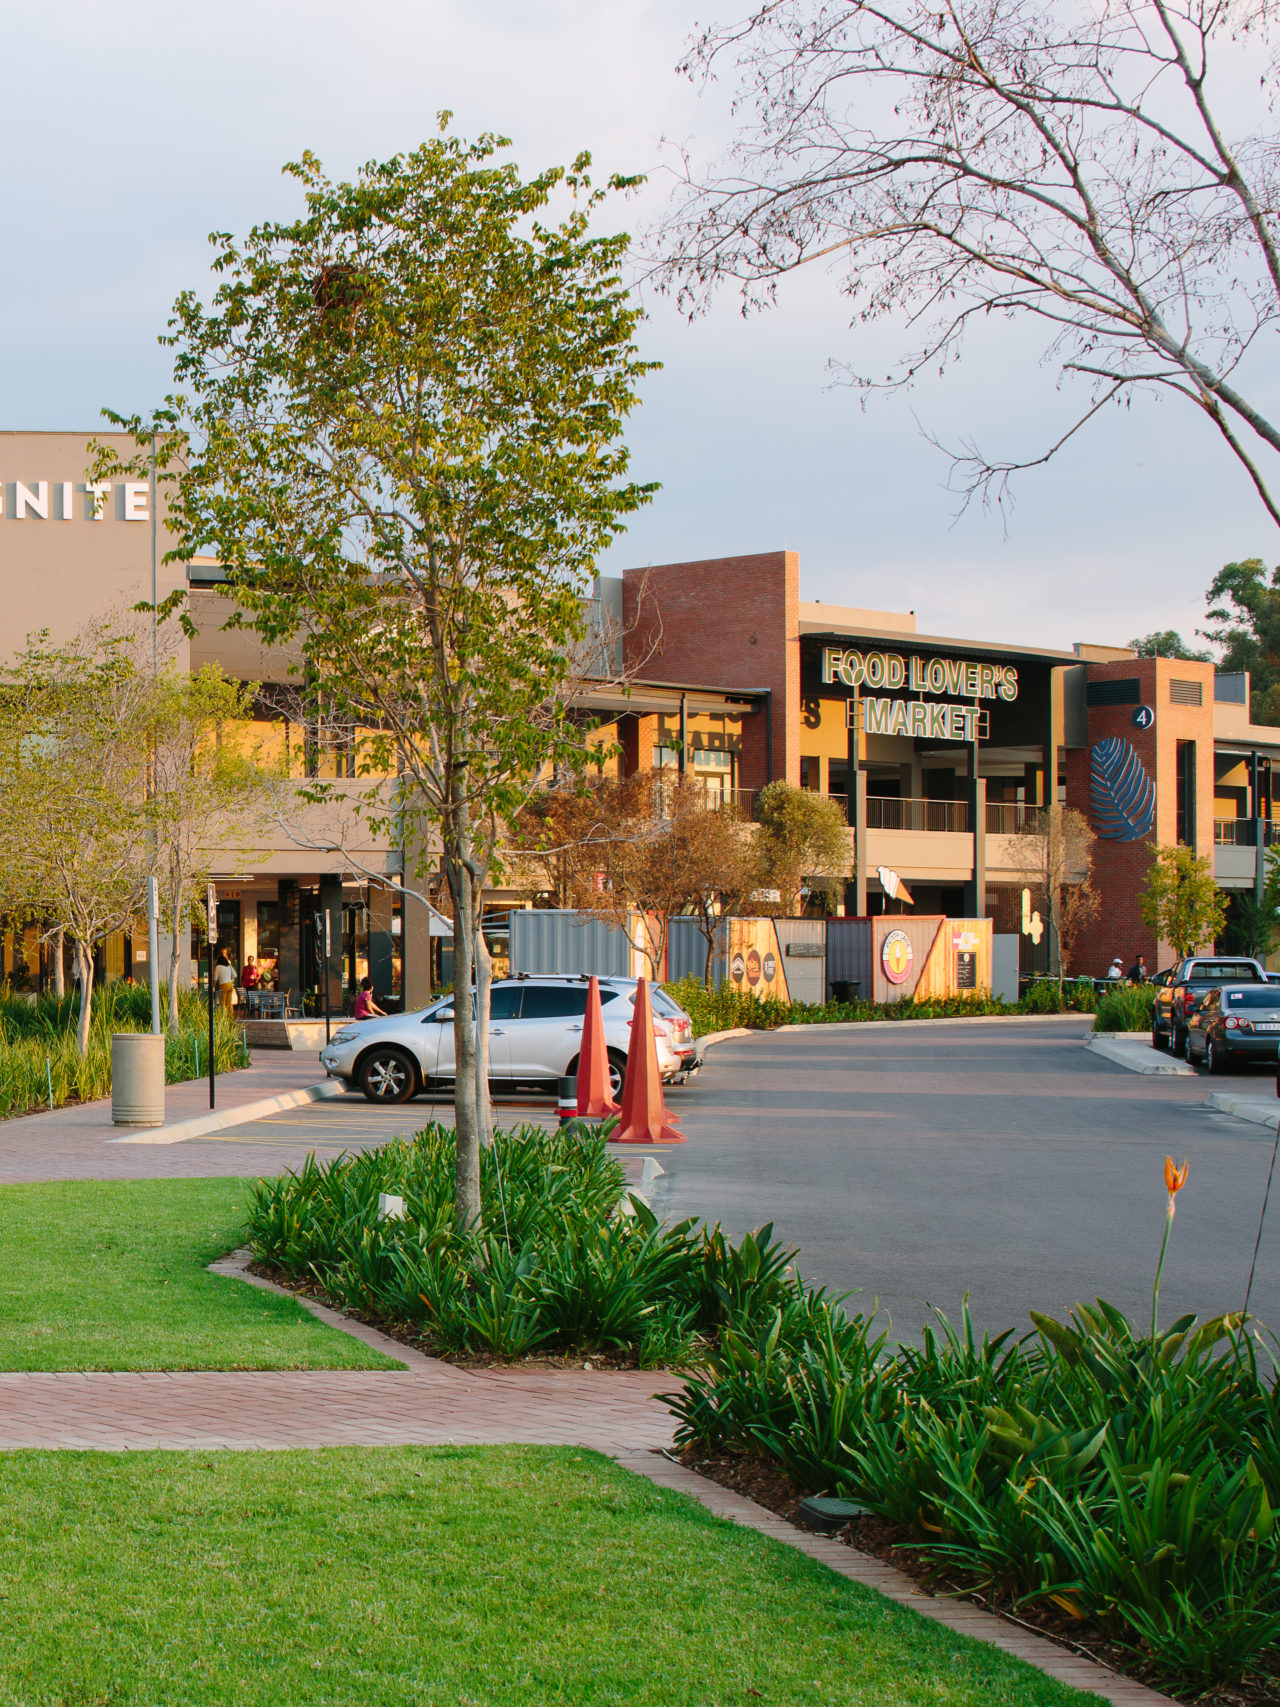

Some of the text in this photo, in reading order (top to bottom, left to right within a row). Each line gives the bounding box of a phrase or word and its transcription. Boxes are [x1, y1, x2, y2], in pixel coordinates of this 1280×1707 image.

[822, 647, 1019, 702] FOOD LOVER'S
[863, 697, 980, 742] MARKET
[1136, 709, 1147, 726] 4
